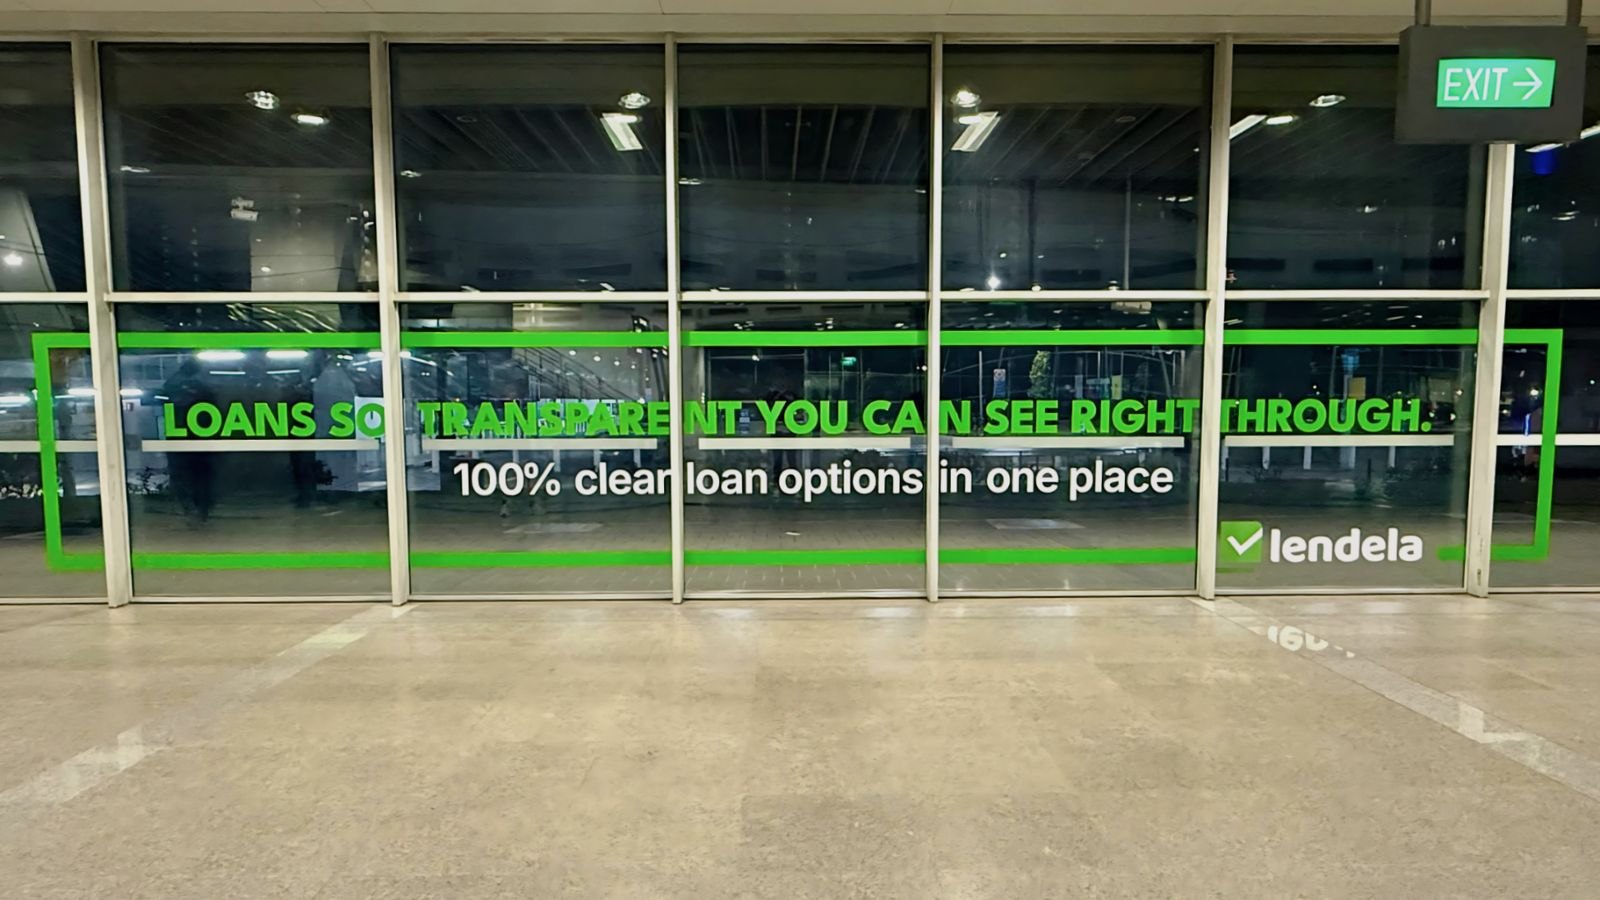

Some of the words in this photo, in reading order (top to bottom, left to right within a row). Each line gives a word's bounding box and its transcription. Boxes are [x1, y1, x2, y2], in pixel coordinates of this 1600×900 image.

[1444, 67, 1508, 101] EXIT
[163, 402, 316, 438] LOANS
[328, 402, 386, 438] SO
[416, 400, 742, 436] TRANSPARENT
[755, 399, 849, 435] YOU
[862, 399, 971, 435] CAN
[983, 399, 1059, 434] SEE
[1071, 399, 1200, 434] RIGHT
[1219, 398, 1432, 433] THROUGH.
[453, 462, 561, 496] 100%
[574, 462, 672, 496] clear
[686, 461, 768, 495] loan
[778, 460, 924, 503] options
[940, 459, 972, 494] in
[986, 467, 1059, 494] one
[1069, 460, 1174, 501] place
[1270, 528, 1423, 563] lendela
